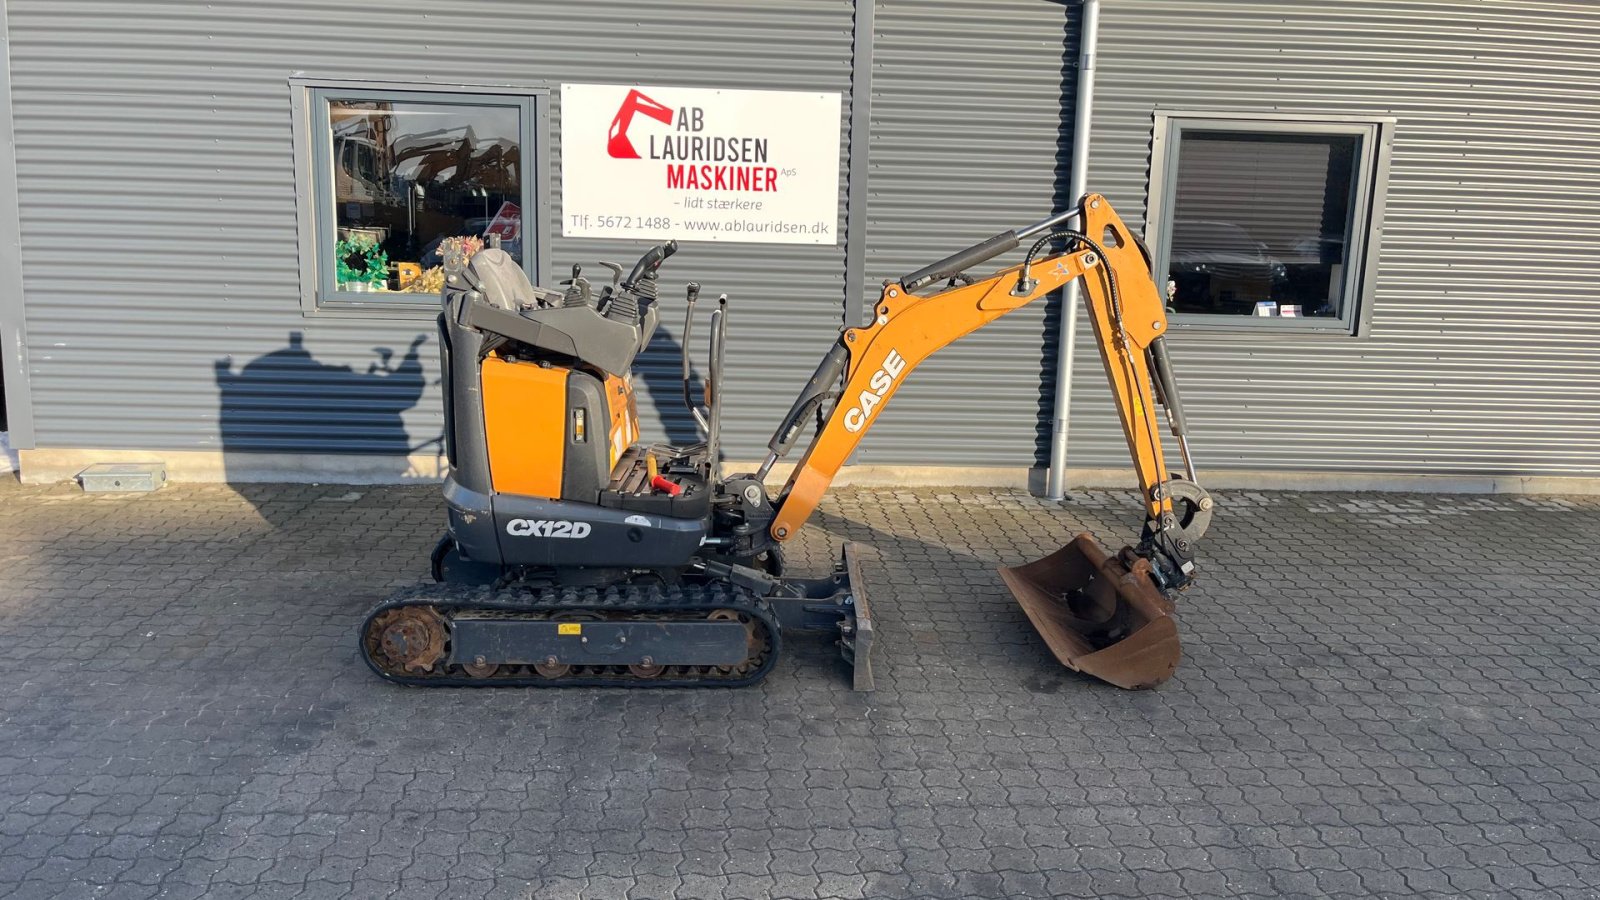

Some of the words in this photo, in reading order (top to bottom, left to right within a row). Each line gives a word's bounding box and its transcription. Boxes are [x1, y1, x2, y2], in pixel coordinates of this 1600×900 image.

[676, 106, 705, 132] AB
[649, 134, 768, 163] LAURIDSEN
[666, 163, 778, 193] MASKINER
[780, 167, 797, 177] ApS
[684, 196, 704, 209] lidt
[707, 197, 763, 211] stærkere
[571, 214, 593, 230] Tlf.
[597, 215, 632, 229] 5672
[636, 216, 671, 230] 1488
[684, 219, 829, 235] www.ablauridsen.dk
[843, 347, 907, 433] CASE
[506, 518, 592, 539] CX12D
